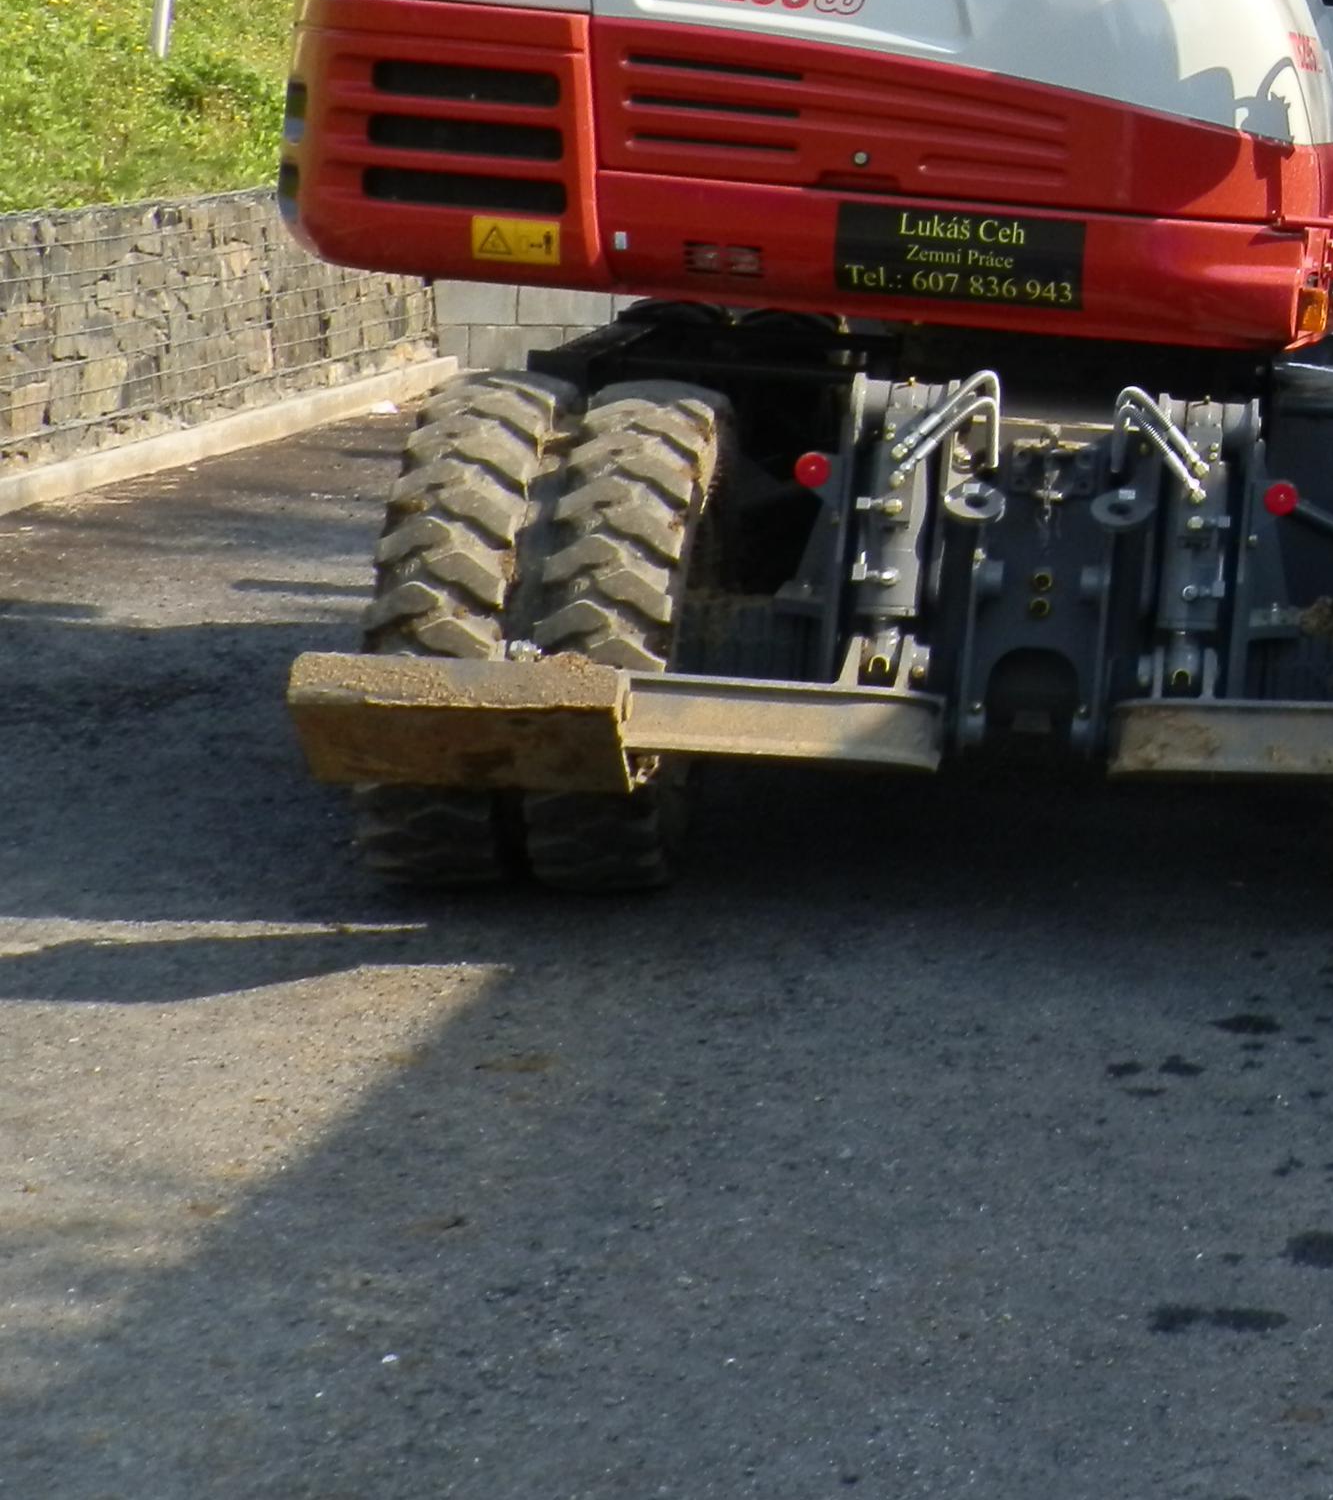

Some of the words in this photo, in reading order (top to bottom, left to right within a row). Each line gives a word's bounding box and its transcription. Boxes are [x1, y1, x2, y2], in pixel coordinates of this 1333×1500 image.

[900, 212, 971, 240] Lukáš
[978, 219, 1026, 244] Ceh
[906, 244, 961, 265] Zemní
[968, 249, 1014, 269] Práce
[845, 264, 902, 289] Tel.:
[912, 270, 960, 293] 607
[969, 274, 1018, 297] 836
[1025, 279, 1073, 302] 943
